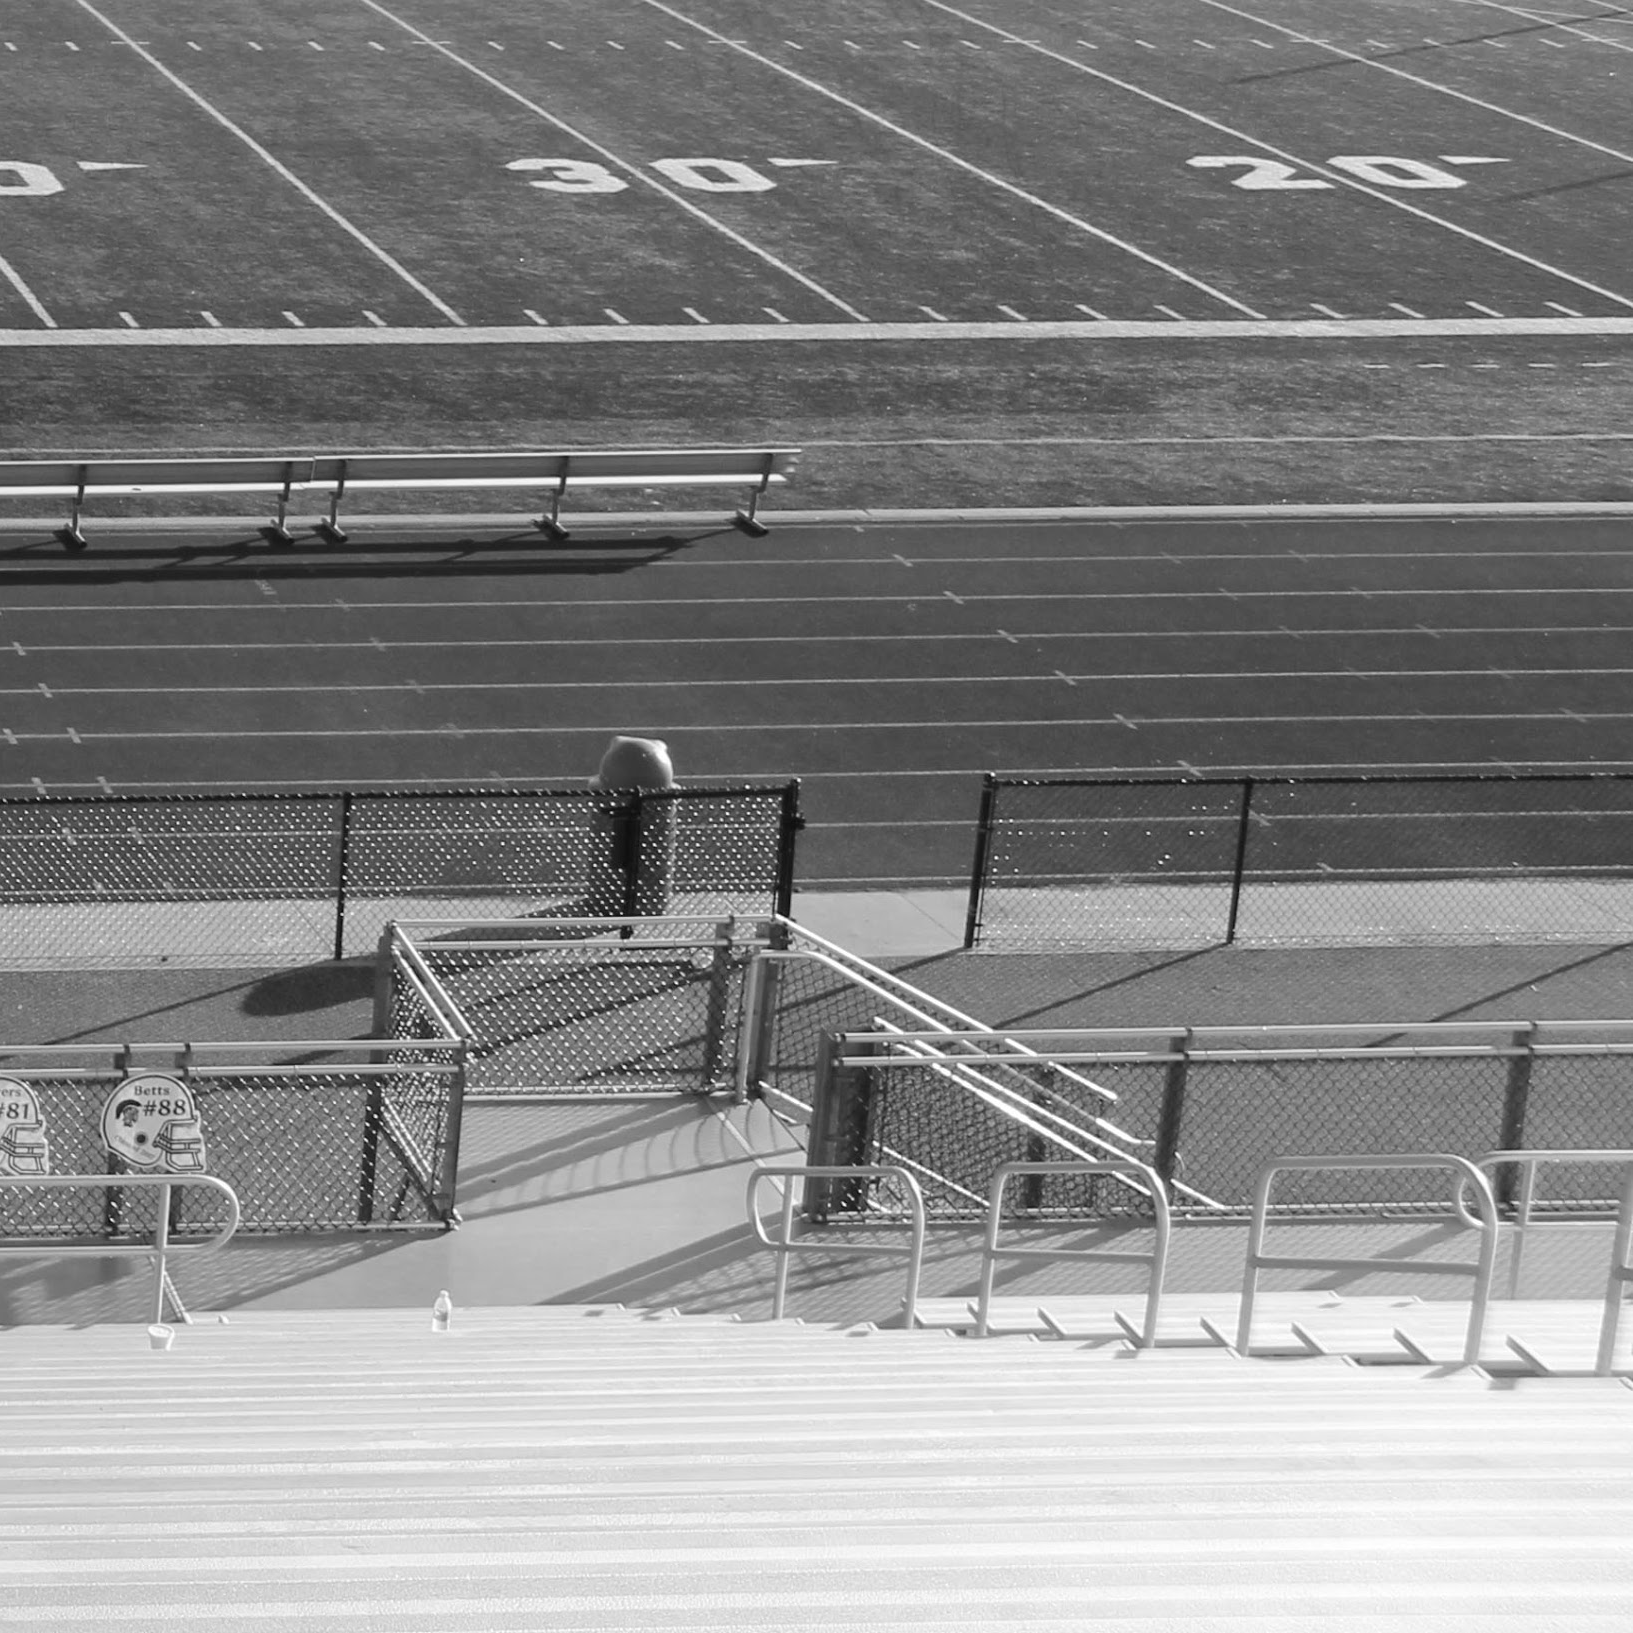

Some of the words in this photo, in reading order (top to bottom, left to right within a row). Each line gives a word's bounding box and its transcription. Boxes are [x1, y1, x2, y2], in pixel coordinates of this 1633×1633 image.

[506, 157, 778, 194] 30
[1186, 154, 1467, 191] 20
[134, 1085, 170, 1096] Betts
[143, 1099, 186, 1116] #88
